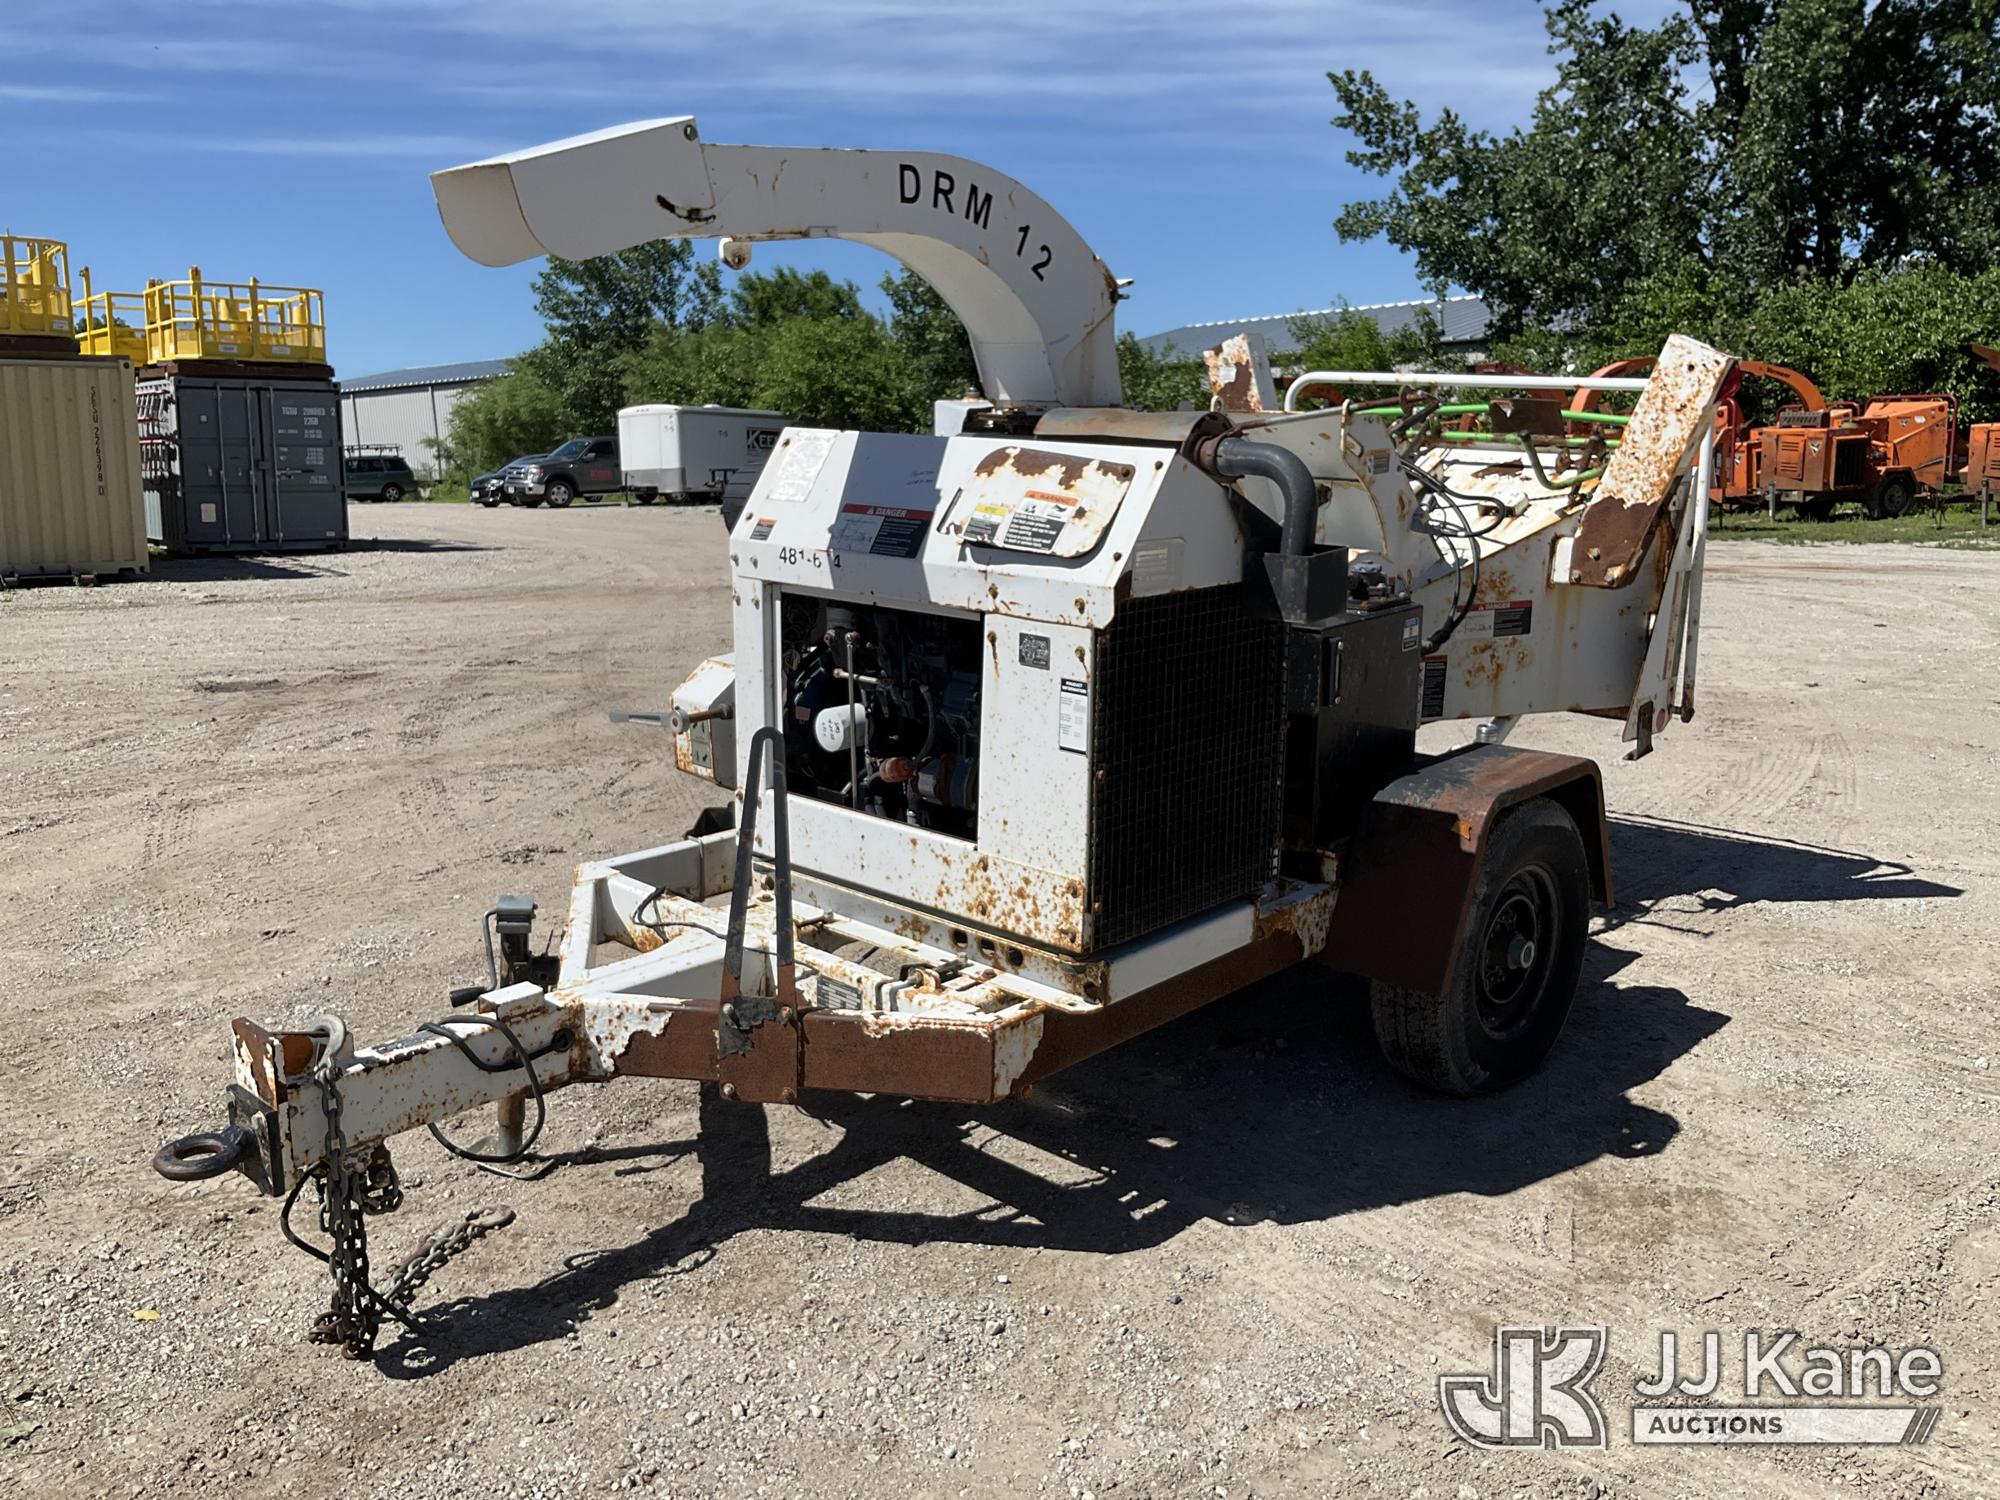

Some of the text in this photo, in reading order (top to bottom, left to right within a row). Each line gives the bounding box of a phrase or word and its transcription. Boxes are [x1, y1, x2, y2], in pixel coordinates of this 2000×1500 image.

[899, 163, 1052, 282] DRM 12
[747, 430, 780, 449] KEE
[875, 507, 908, 519] DANGER
[1484, 601, 1511, 610] DANGER
